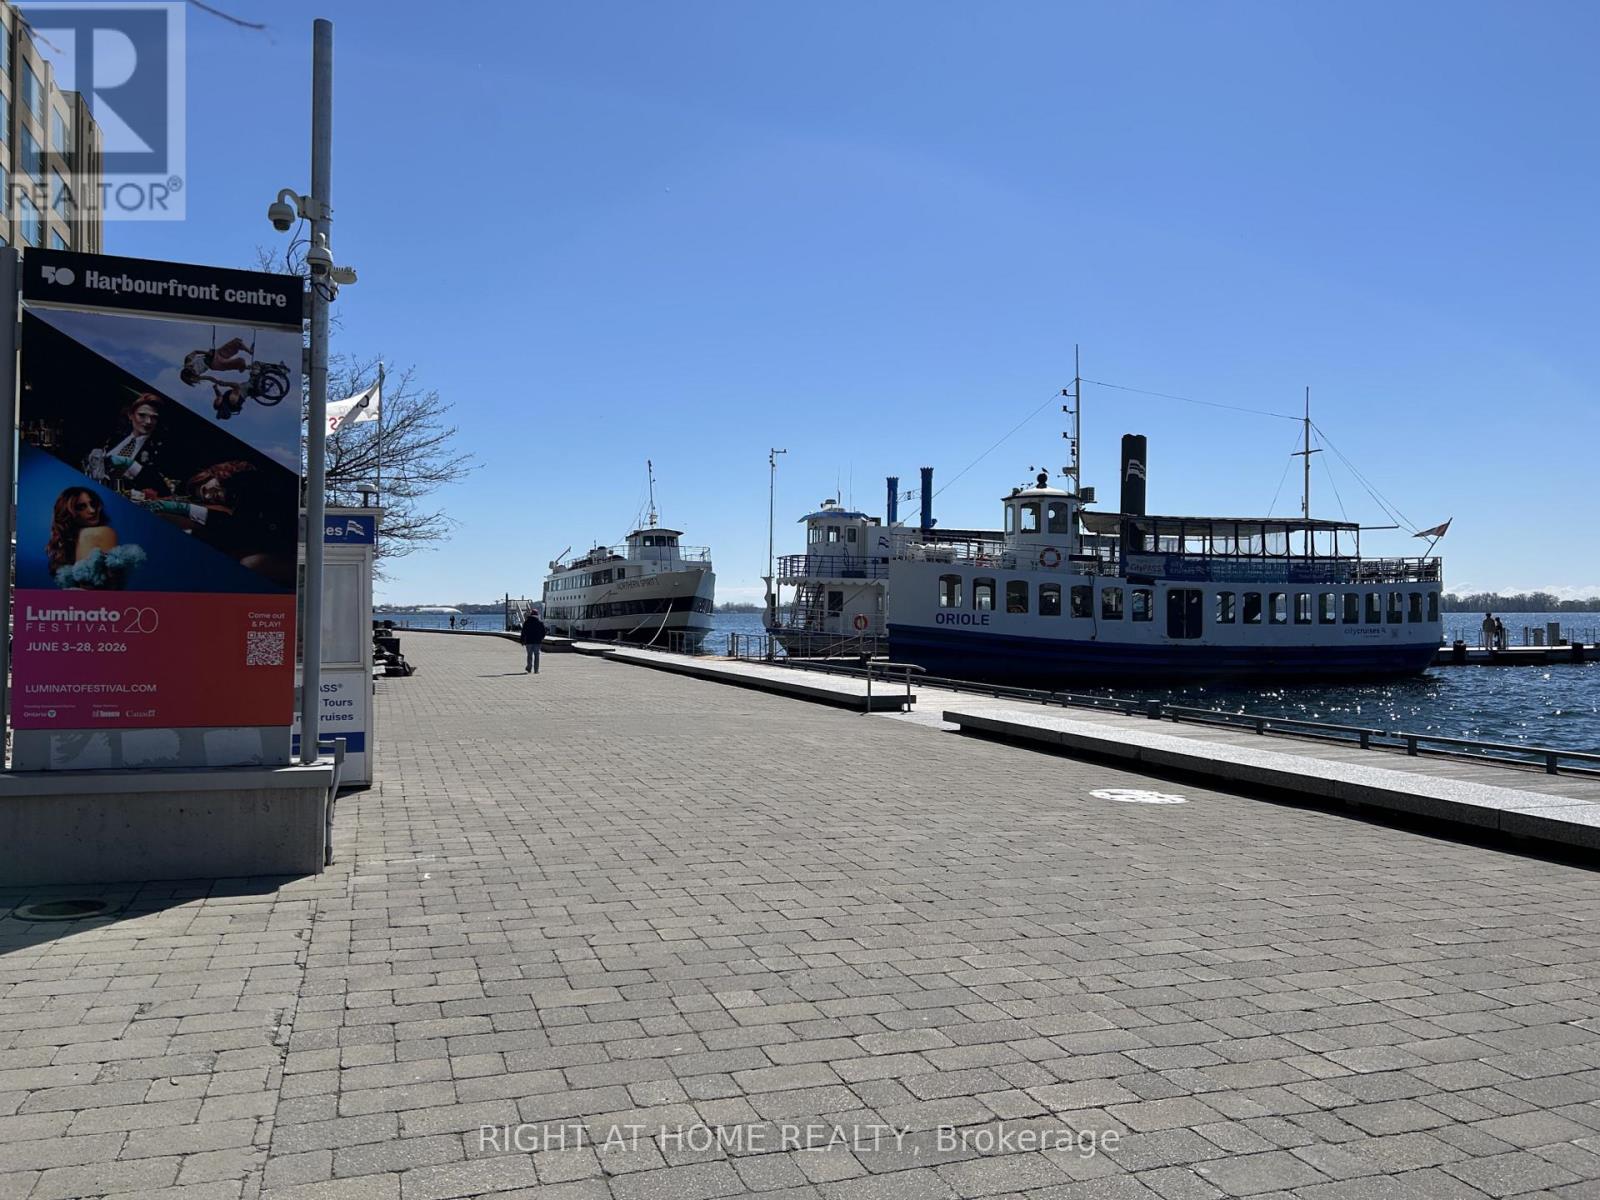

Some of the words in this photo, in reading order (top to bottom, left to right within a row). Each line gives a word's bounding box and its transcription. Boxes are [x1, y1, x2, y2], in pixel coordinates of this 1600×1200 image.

[85, 270, 219, 301] Harbourfront
[224, 284, 287, 307] centre
[26, 606, 120, 621] Luminato
[123, 607, 159, 634] 20
[248, 612, 270, 620] Come
[272, 612, 285, 620] out
[935, 612, 990, 626] ORIOLE
[26, 623, 118, 633] FESTIVAL
[26, 642, 59, 652] JUNE
[97, 642, 127, 652] 2026
[25, 684, 157, 694] LUMINATOFESTIVAL.COM
[323, 698, 352, 706] Tours
[320, 712, 353, 721] ruises
